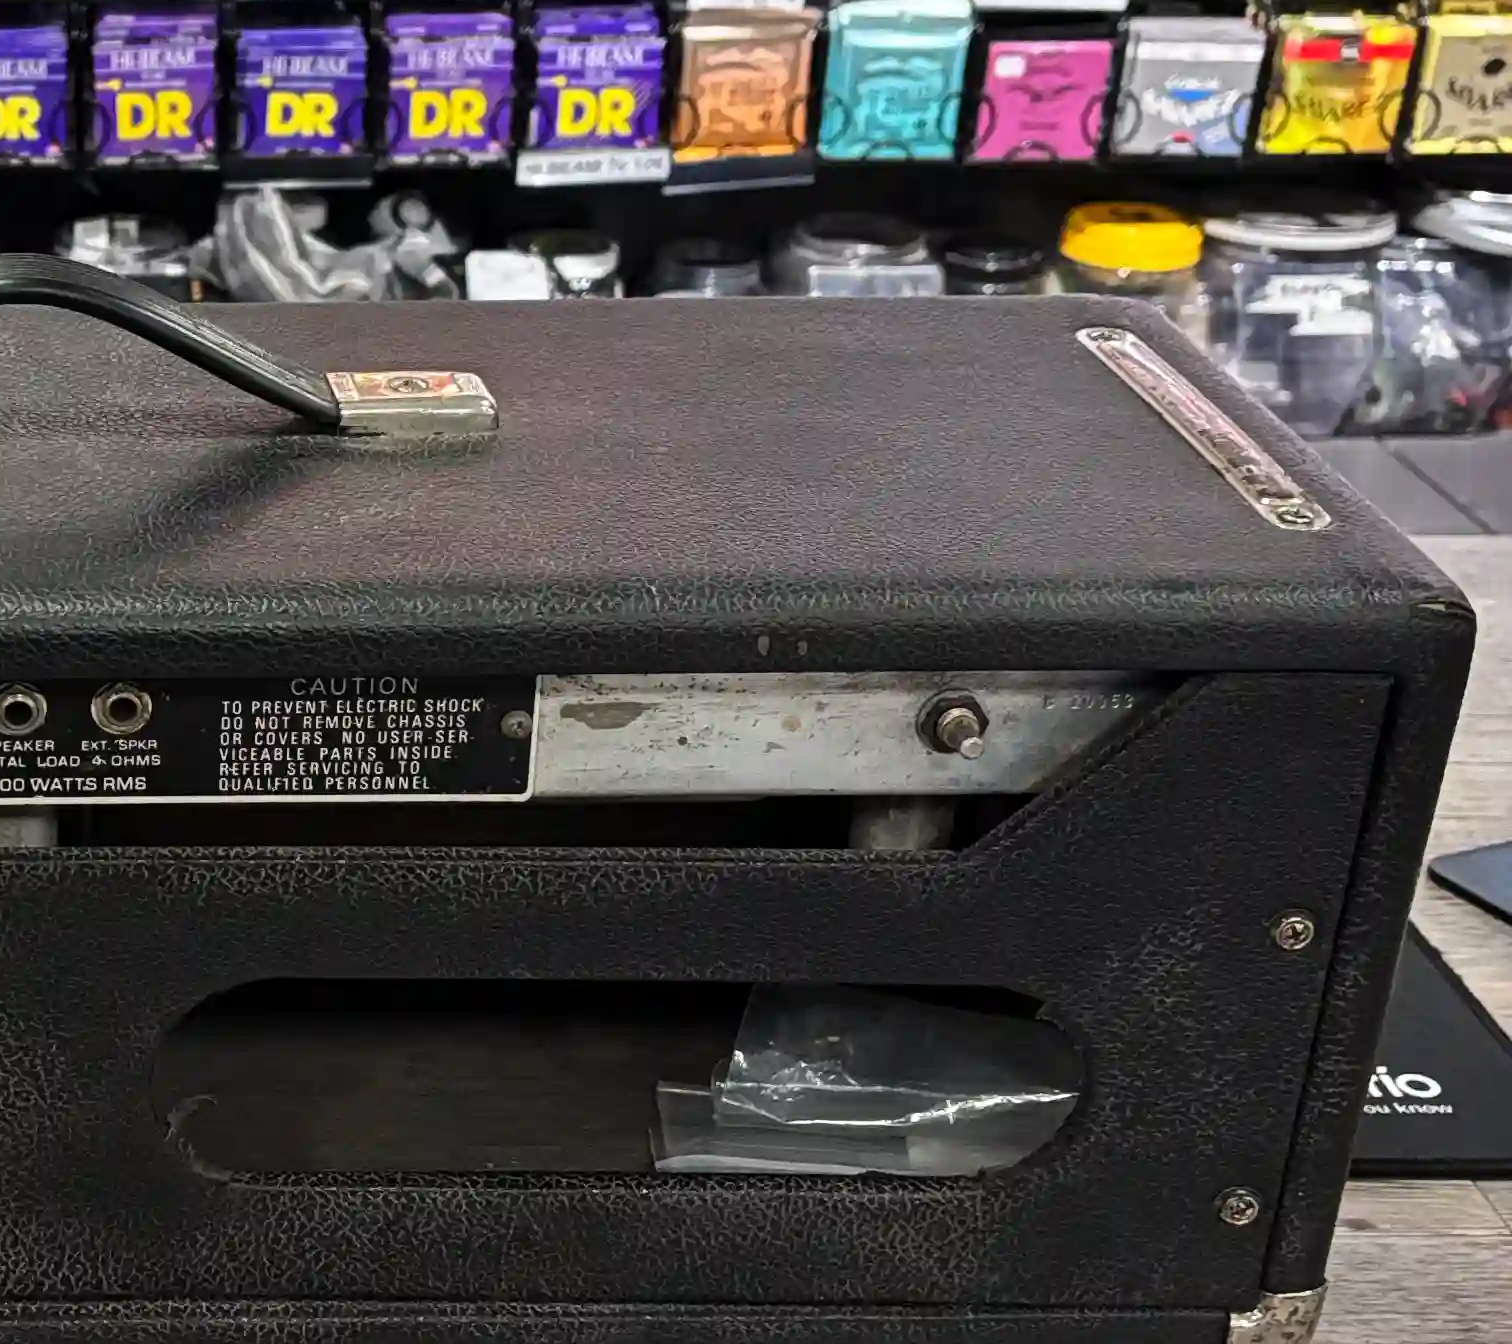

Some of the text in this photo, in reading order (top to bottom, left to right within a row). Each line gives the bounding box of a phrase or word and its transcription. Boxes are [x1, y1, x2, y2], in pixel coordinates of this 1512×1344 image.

[116, 90, 192, 142] DR
[266, 91, 339, 138] DR
[409, 88, 487, 140] DR
[556, 87, 635, 138] DR
[290, 677, 419, 696] CAUTION
[222, 698, 484, 714] TO PREVENT ELECTRIC SHOCK
[221, 714, 467, 730] DO NOT REMOVE CHASSIS
[81, 739, 158, 751] EXT. SPKR
[220, 732, 242, 746] OR
[254, 731, 323, 745] COVERS
[341, 730, 366, 744] NO
[37, 756, 80, 767] LOAD
[92, 755, 103, 766] 4
[111, 755, 161, 766] OHMS
[219, 747, 305, 761] VICEABLE
[319, 747, 377, 761] PARTS
[220, 760, 420, 776] REFER SERVICING TO
[30, 777, 96, 791] WATTS
[103, 777, 147, 790] RMS
[219, 777, 313, 791] QUALIFIED
